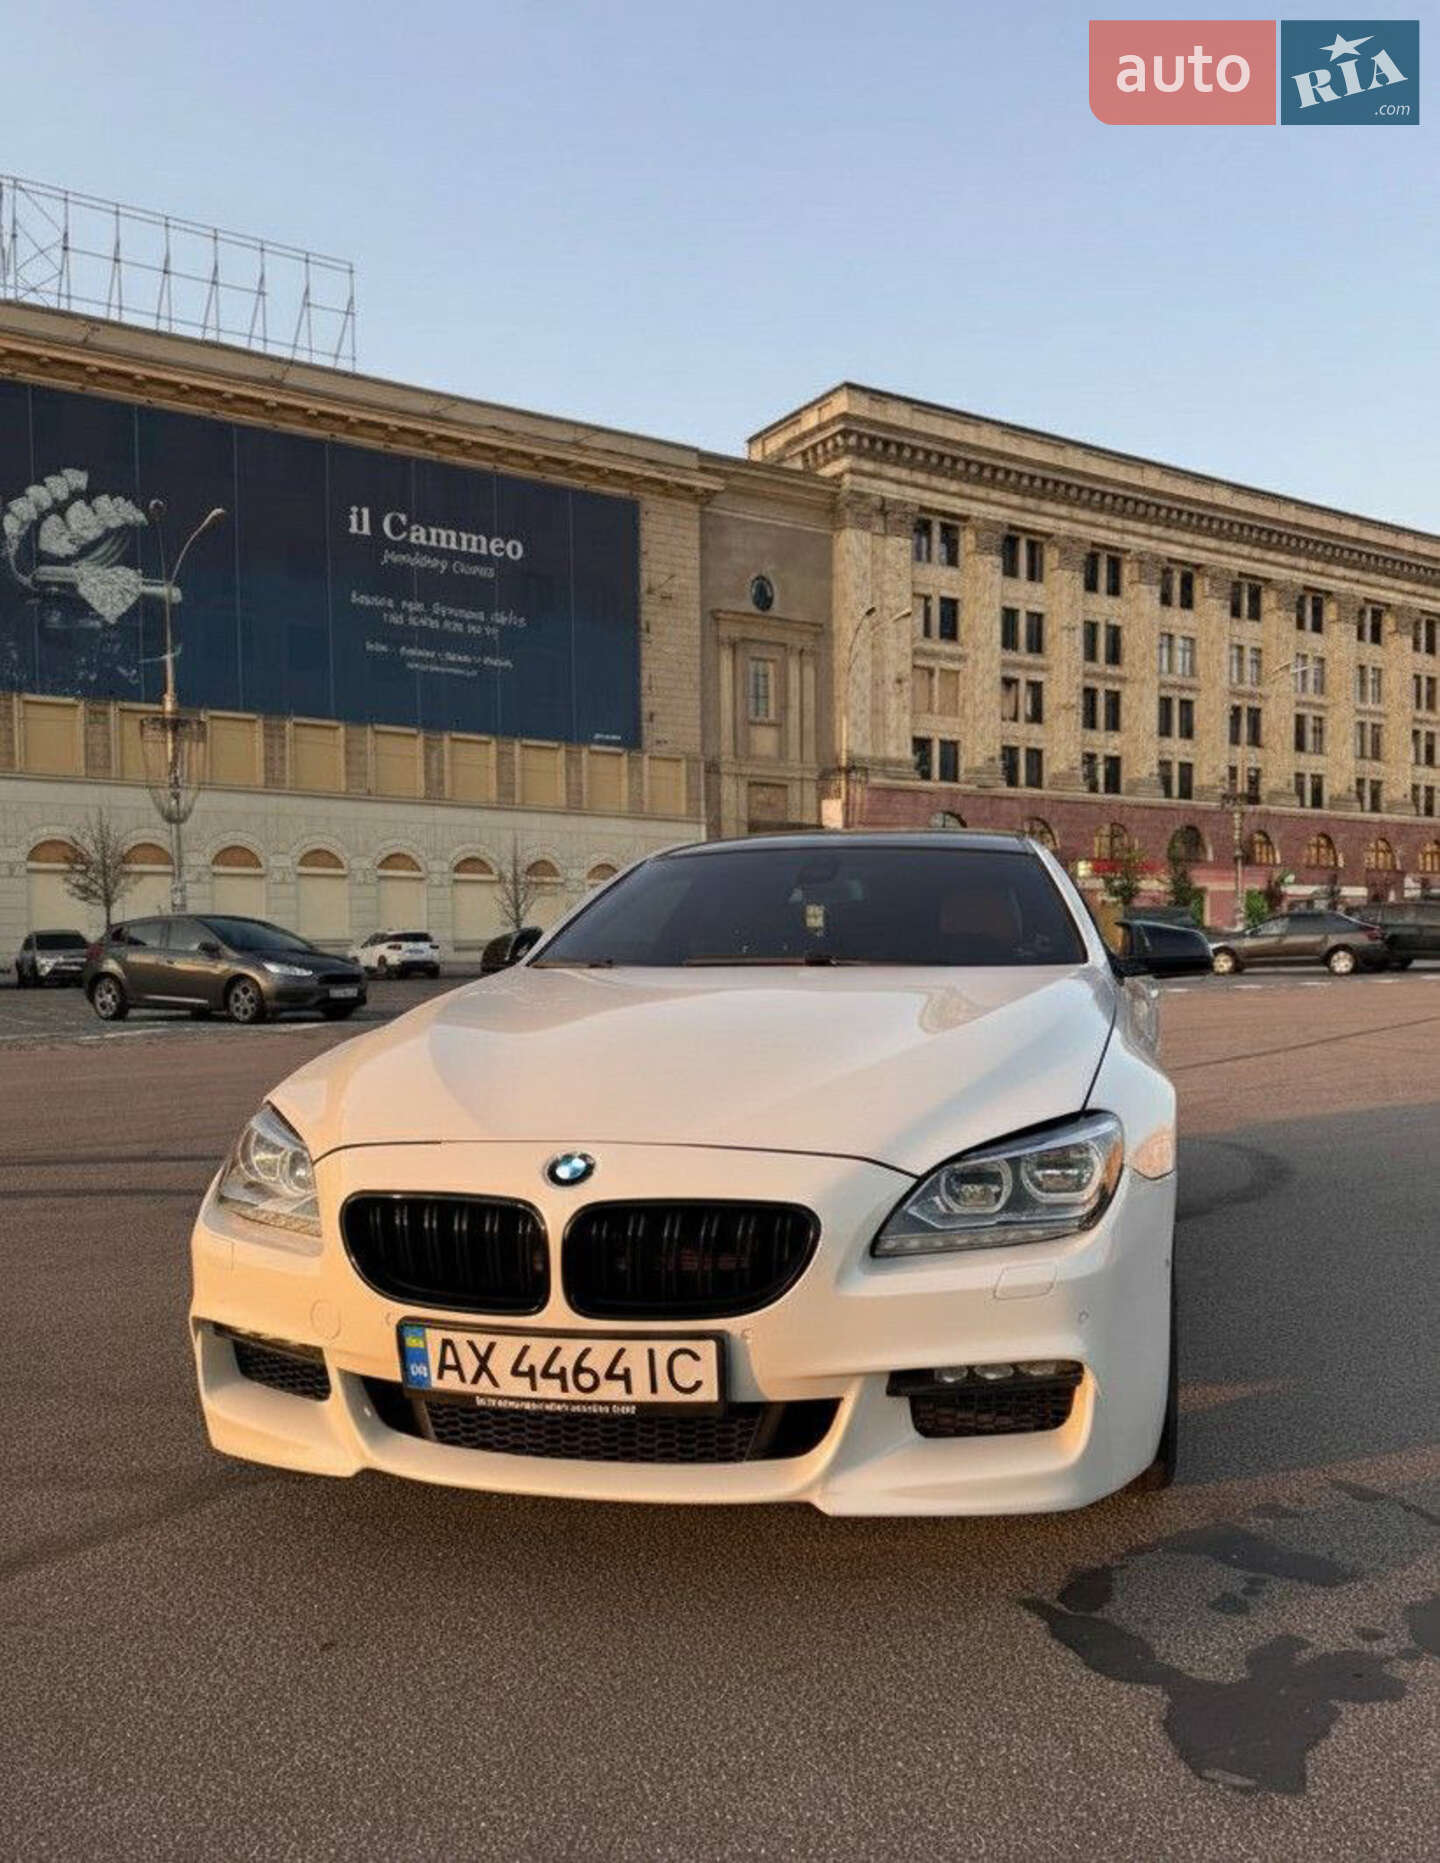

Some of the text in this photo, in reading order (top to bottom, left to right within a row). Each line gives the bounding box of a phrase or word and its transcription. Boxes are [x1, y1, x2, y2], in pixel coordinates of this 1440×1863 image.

[348, 505, 524, 561] il Cammeo
[436, 1338, 704, 1395] AX 4464 IC
